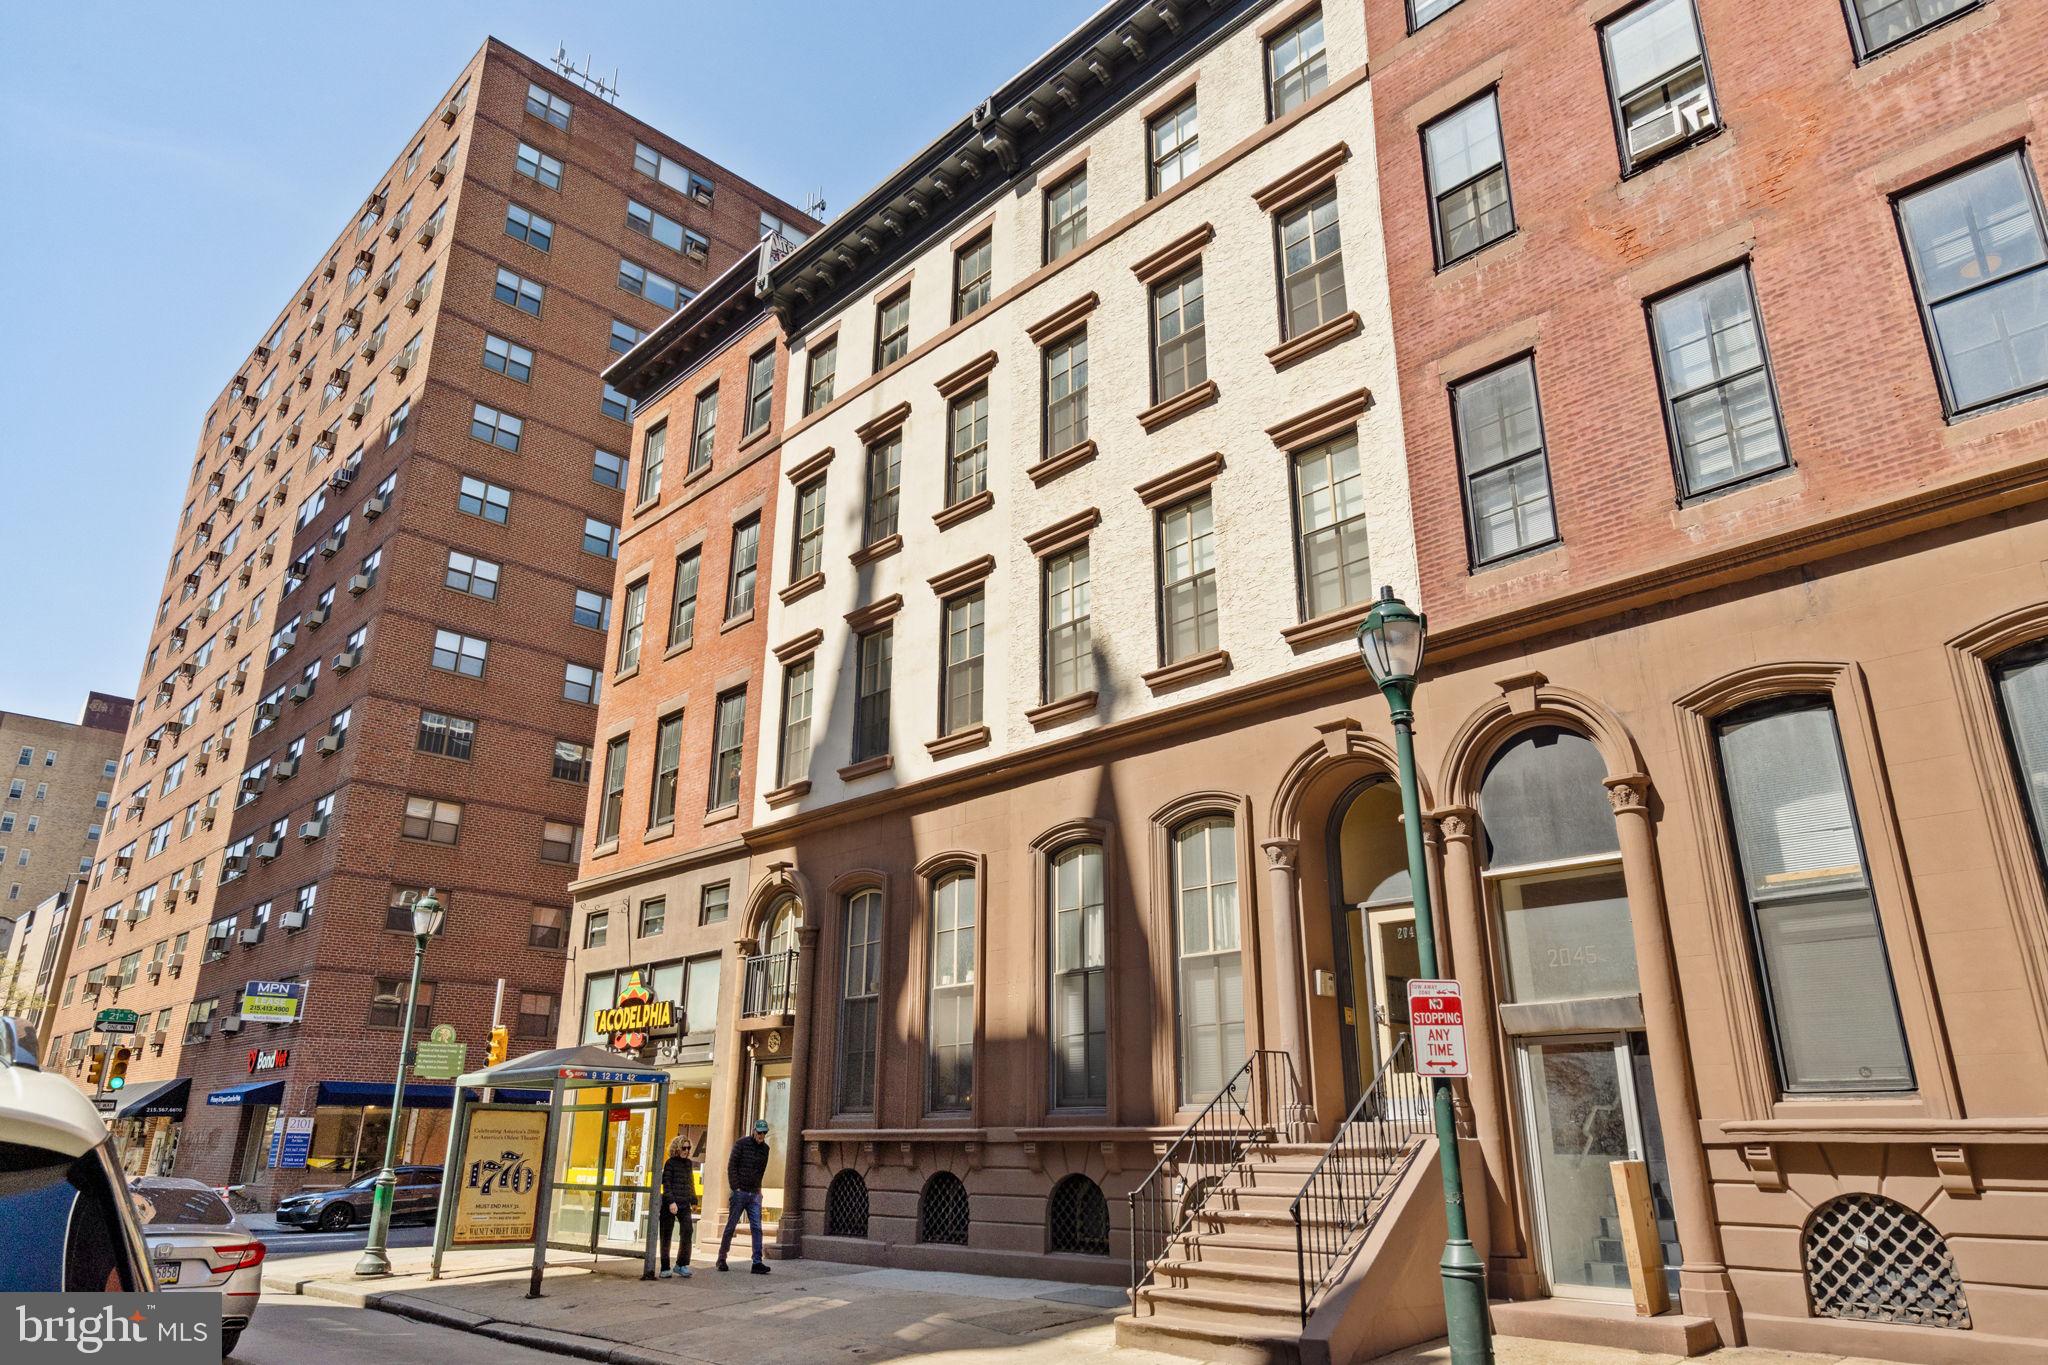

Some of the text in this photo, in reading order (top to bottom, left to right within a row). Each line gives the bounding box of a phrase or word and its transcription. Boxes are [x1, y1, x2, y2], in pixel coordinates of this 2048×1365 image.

[1397, 927, 1415, 939] 204
[1547, 945, 1596, 966] 2045
[257, 983, 290, 993] MPN
[255, 997, 287, 1005] LEASE
[1428, 999, 1443, 1010] NO
[108, 1012, 124, 1020] 21st
[593, 1001, 671, 1033] TACODELPHIA
[1413, 1012, 1461, 1024] STOPPING
[1428, 1029, 1450, 1041] ANY
[1427, 1043, 1454, 1056] TIME
[289, 1119, 311, 1129] 2101
[467, 1150, 536, 1196] 1776
[470, 1226, 531, 1235] WALNUT STREET THEATRE
